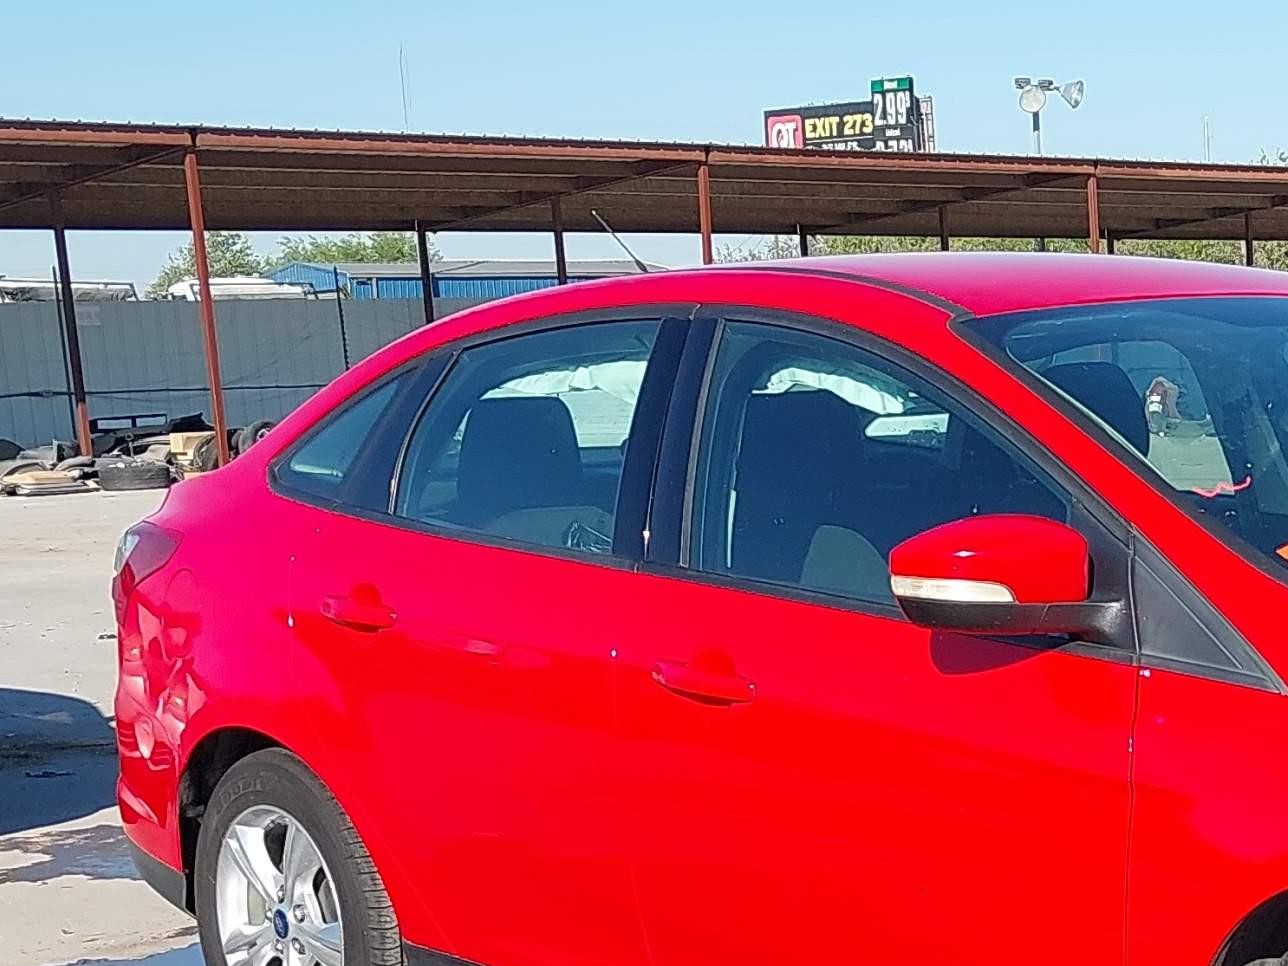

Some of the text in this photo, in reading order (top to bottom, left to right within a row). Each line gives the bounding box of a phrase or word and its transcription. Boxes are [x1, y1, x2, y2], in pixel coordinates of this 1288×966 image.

[771, 122, 796, 148] QT
[804, 117, 841, 139] EXIT
[843, 113, 874, 136] 273
